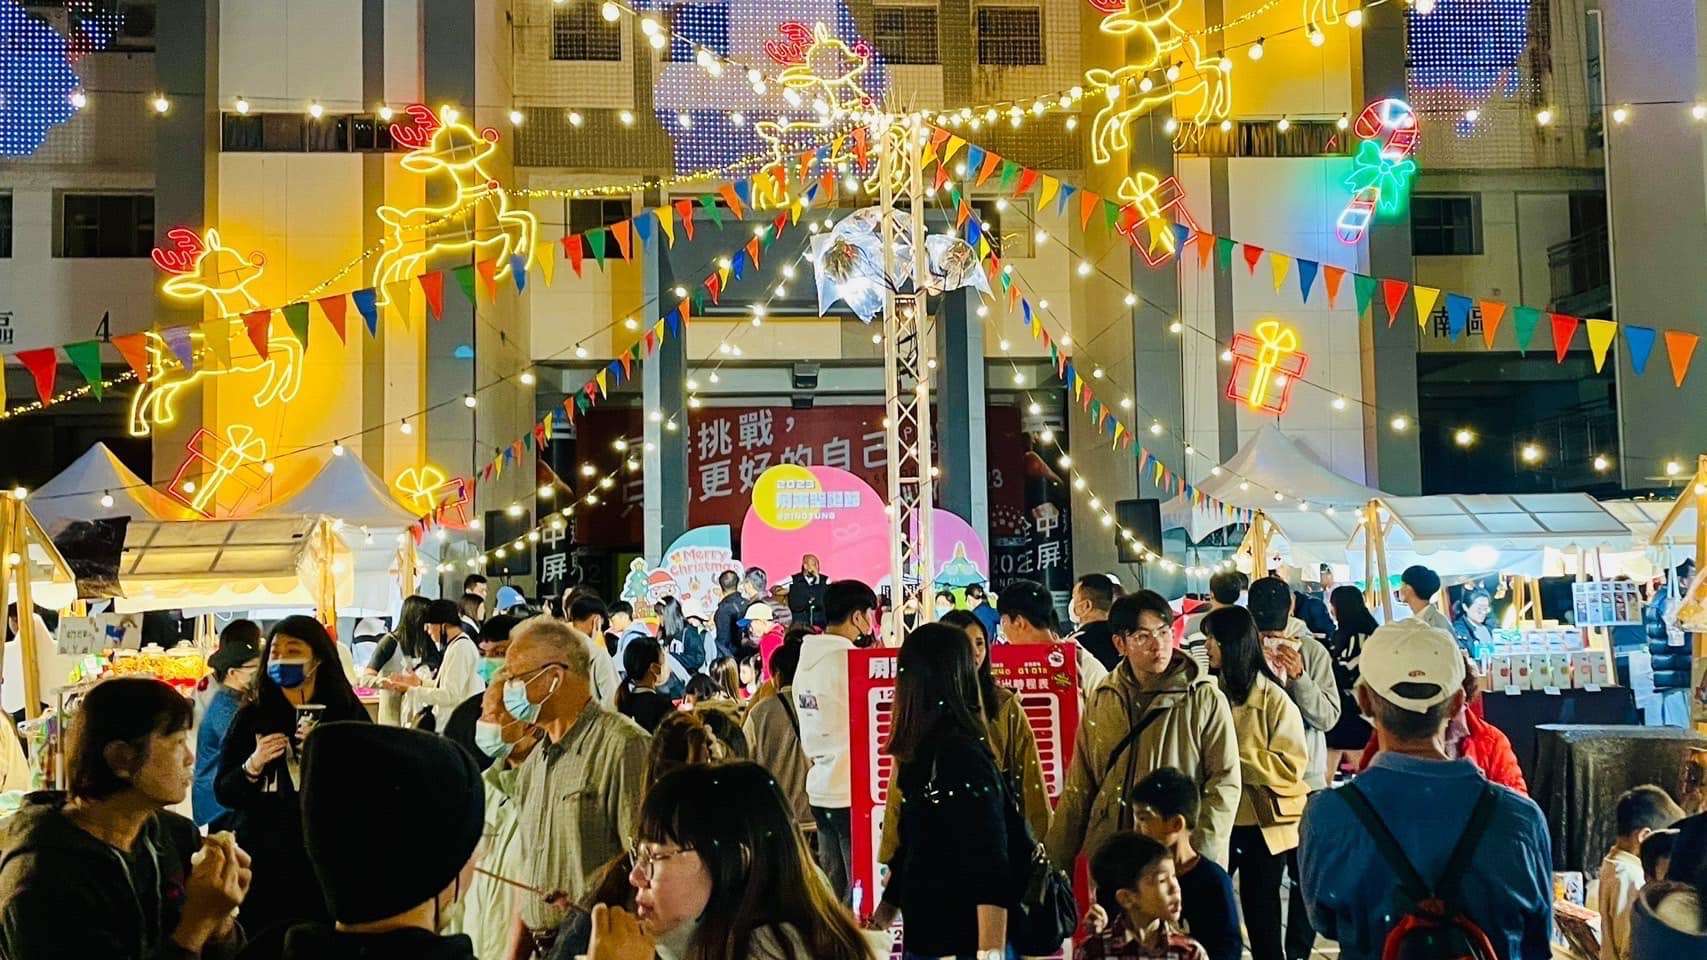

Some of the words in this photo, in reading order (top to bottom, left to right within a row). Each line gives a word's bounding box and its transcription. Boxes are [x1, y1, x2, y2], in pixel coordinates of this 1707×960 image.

[96, 311, 112, 343] 4
[776, 480, 815, 489] 2023
[683, 549, 729, 562] Merry
